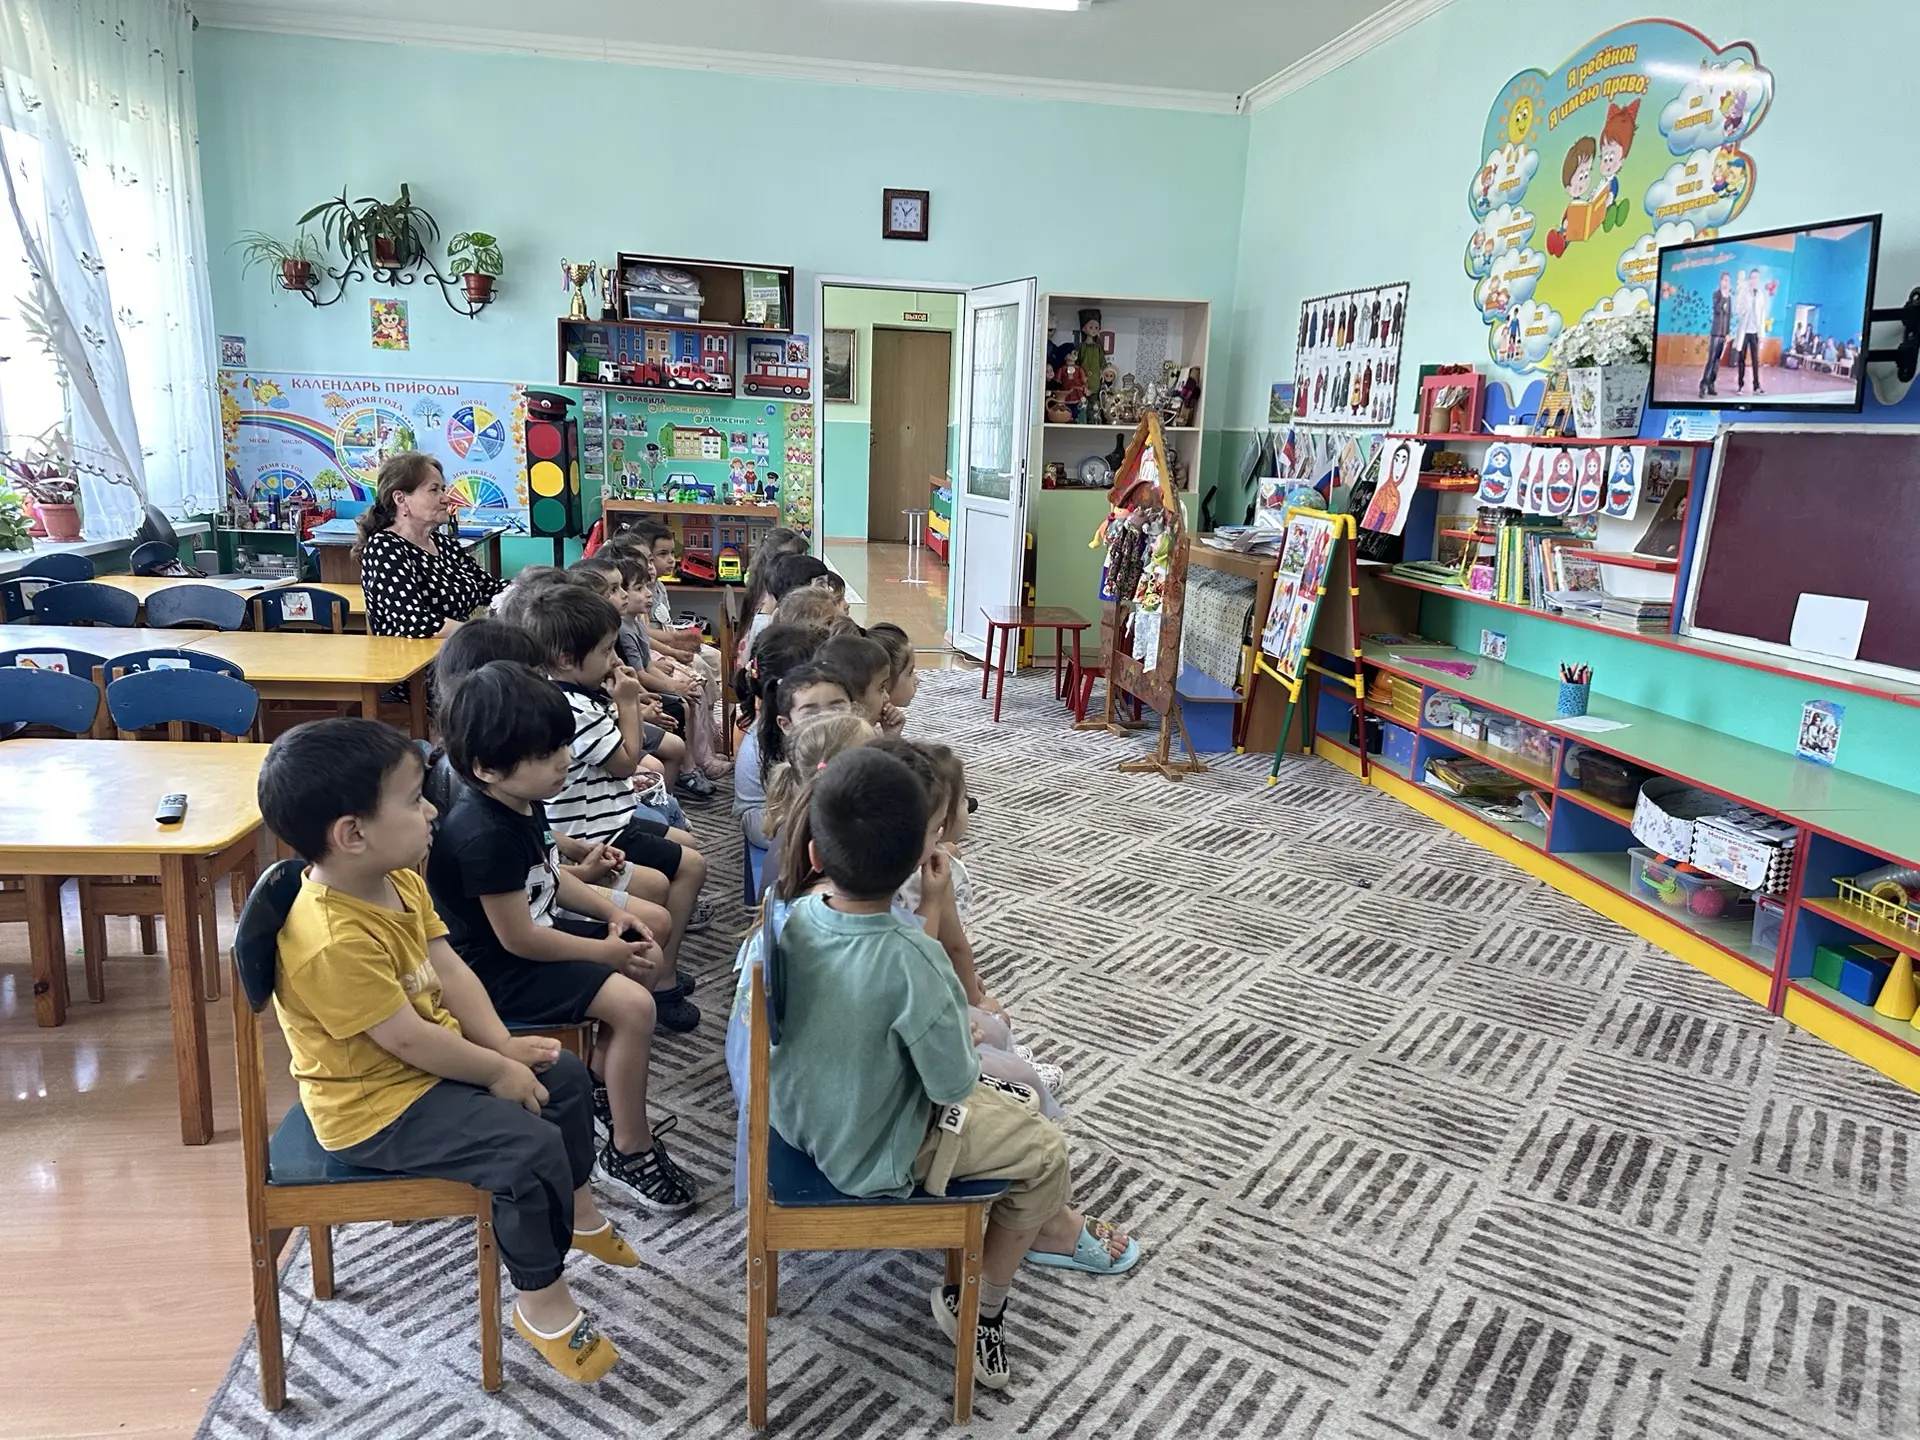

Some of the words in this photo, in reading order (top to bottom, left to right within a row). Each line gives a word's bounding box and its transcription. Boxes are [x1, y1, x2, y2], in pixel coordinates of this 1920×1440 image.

[1567, 68, 1578, 90] Я
[1579, 44, 1638, 87] ребёнок
[1548, 109, 1558, 131] Я
[1560, 83, 1600, 121] имею
[1602, 75, 1650, 102] право:
[1690, 95, 1703, 109] на
[1674, 109, 1713, 130] защиту
[1686, 163, 1698, 176] на
[1656, 193, 1719, 218] гражданство
[904, 313, 927, 322] ВЫХОД
[291, 377, 381, 393] КАЛЕНДАРЬ
[385, 381, 460, 396] ПРИРОДЫ
[344, 396, 377, 409] ВРЕМЯ
[378, 396, 403, 412] ГОДА
[460, 399, 487, 407] ПОГОДА
[626, 395, 666, 405] ПРАВИЛА
[657, 404, 711, 415] ДОРОЖНОГО
[703, 416, 750, 425] ДВИЖЕНИЯ
[256, 462, 279, 473] ВРЕМЯ
[281, 462, 303, 474] СУТОК
[452, 470, 469, 480] ДЕНЬ
[470, 469, 497, 481] НЕДЕЛИ
[1707, 831, 1759, 853] Монтессори
